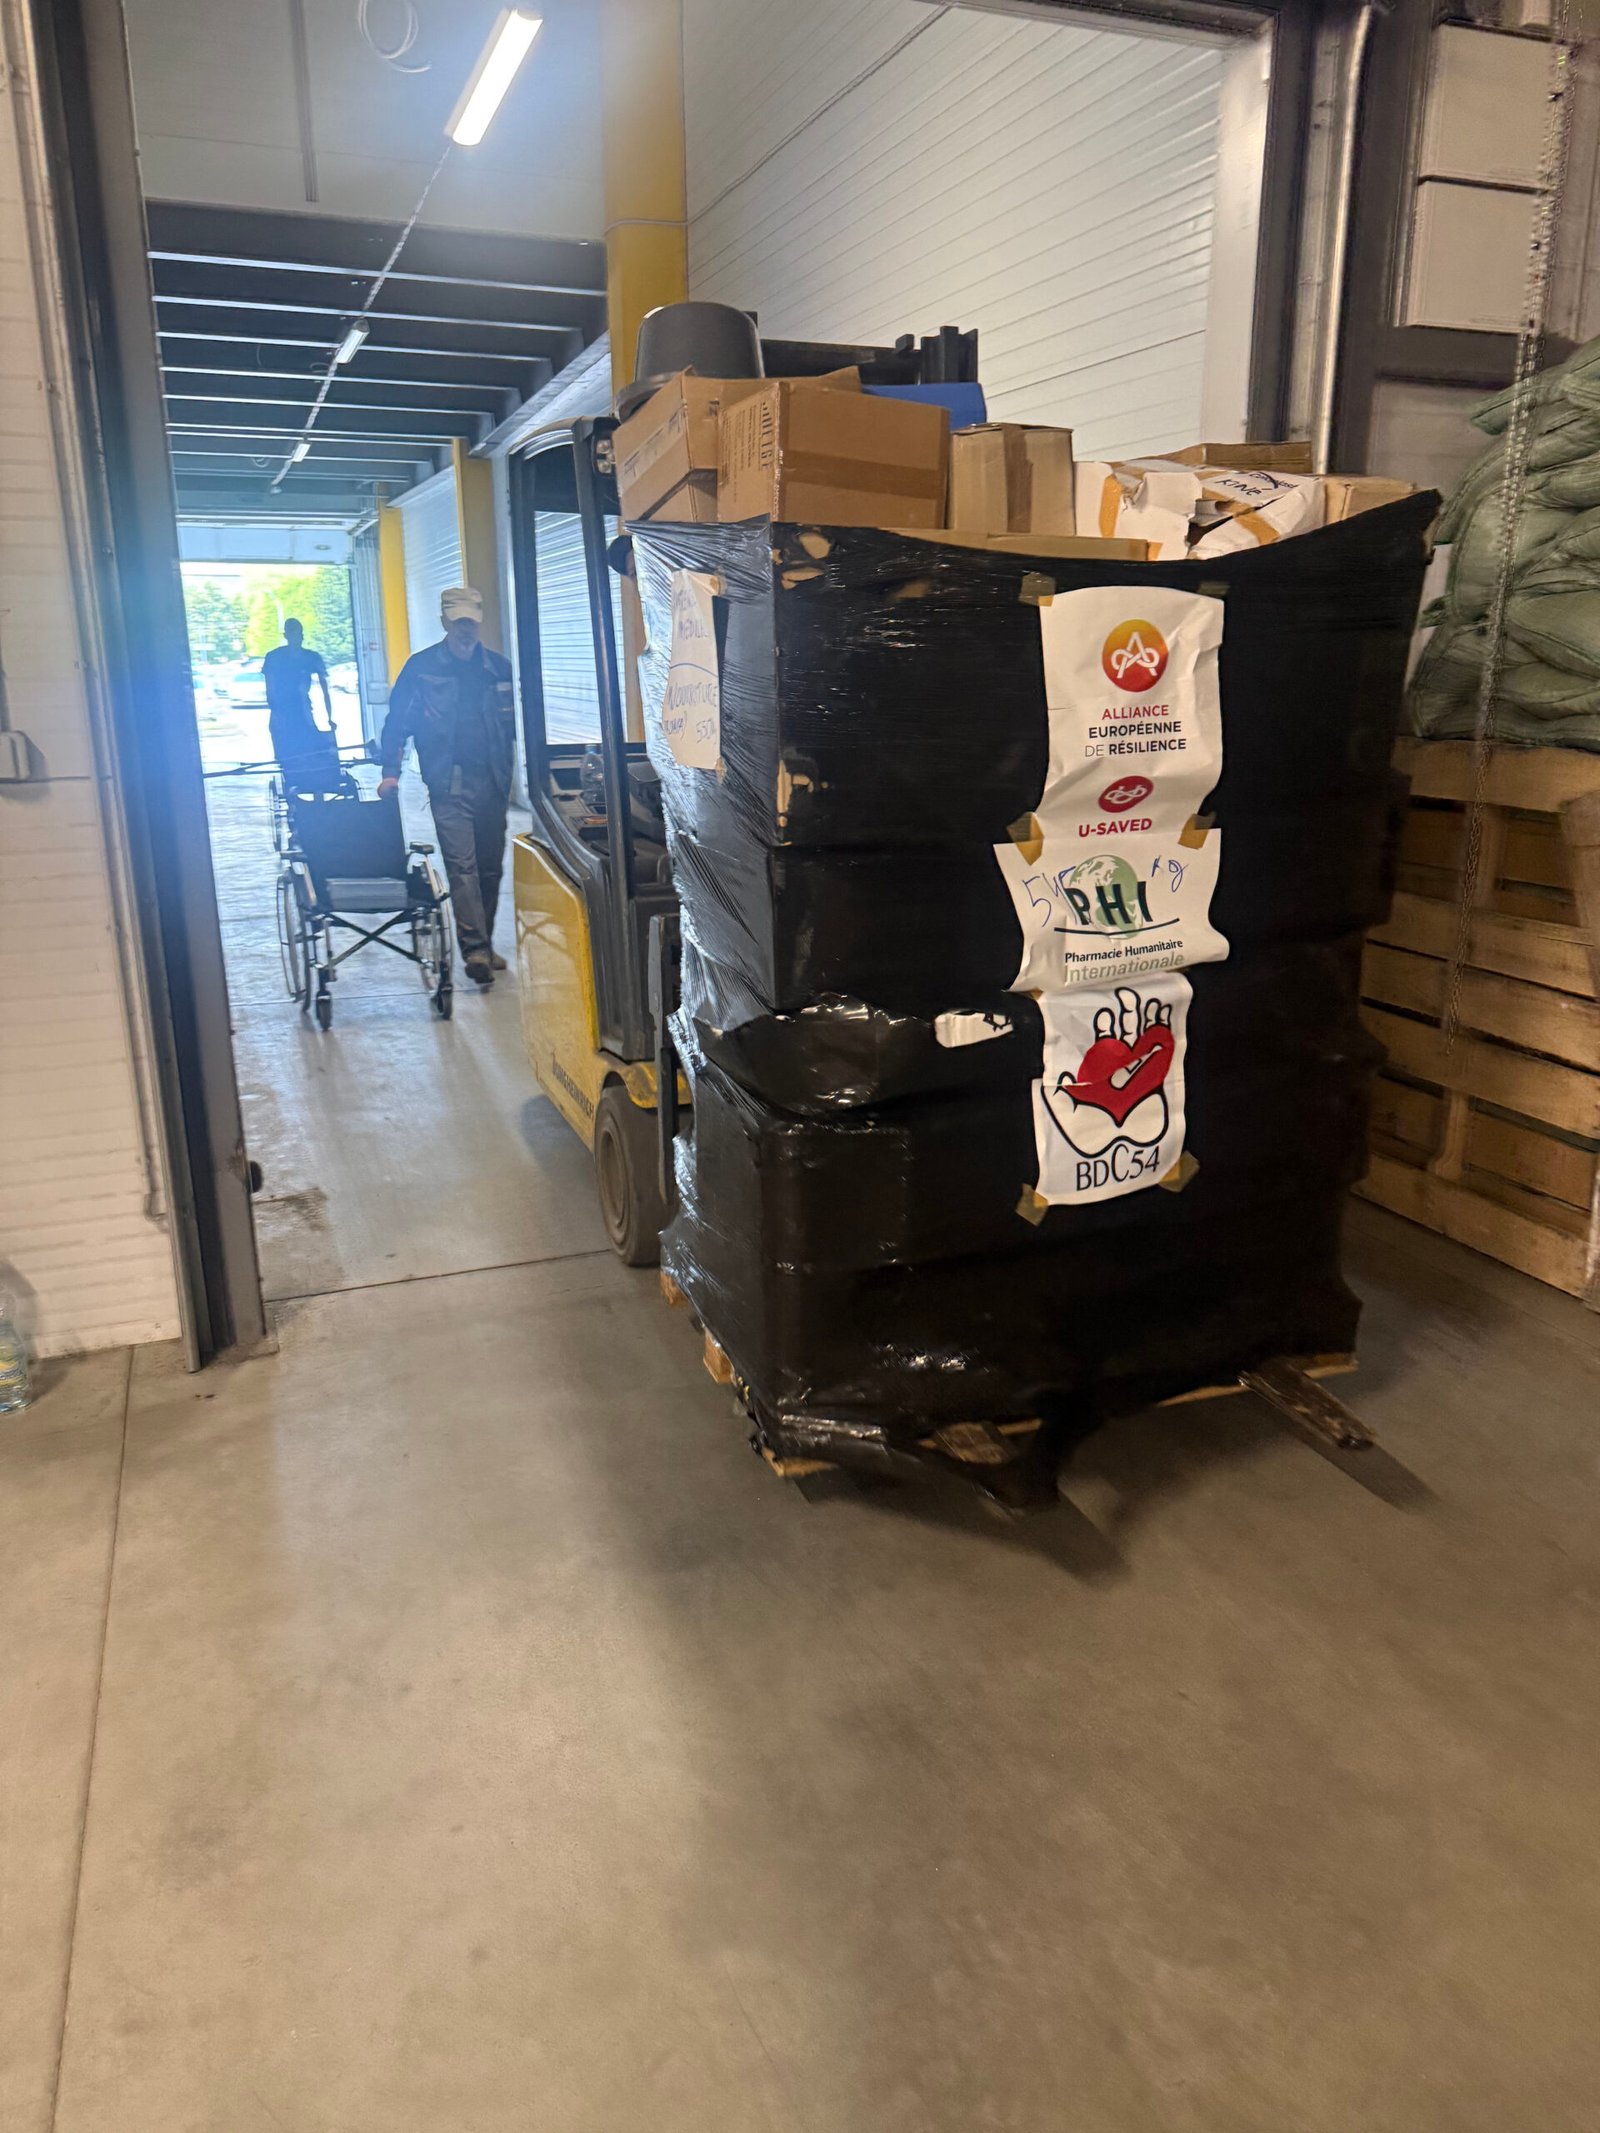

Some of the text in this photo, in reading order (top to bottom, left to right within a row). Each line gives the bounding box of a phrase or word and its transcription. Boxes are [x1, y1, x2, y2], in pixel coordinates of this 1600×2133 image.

[1101, 704, 1169, 721] ALLIANCE
[1088, 720, 1182, 739] EUROPÉENNE
[1084, 738, 1187, 758] DE RÉSILIENCE
[1078, 818, 1153, 838] U-SAVED
[1063, 881, 1153, 926] PHI
[1064, 938, 1184, 964] Pharmacie Humanitaire
[1064, 951, 1185, 986] Internationale
[1075, 1142, 1160, 1192] BDC54
